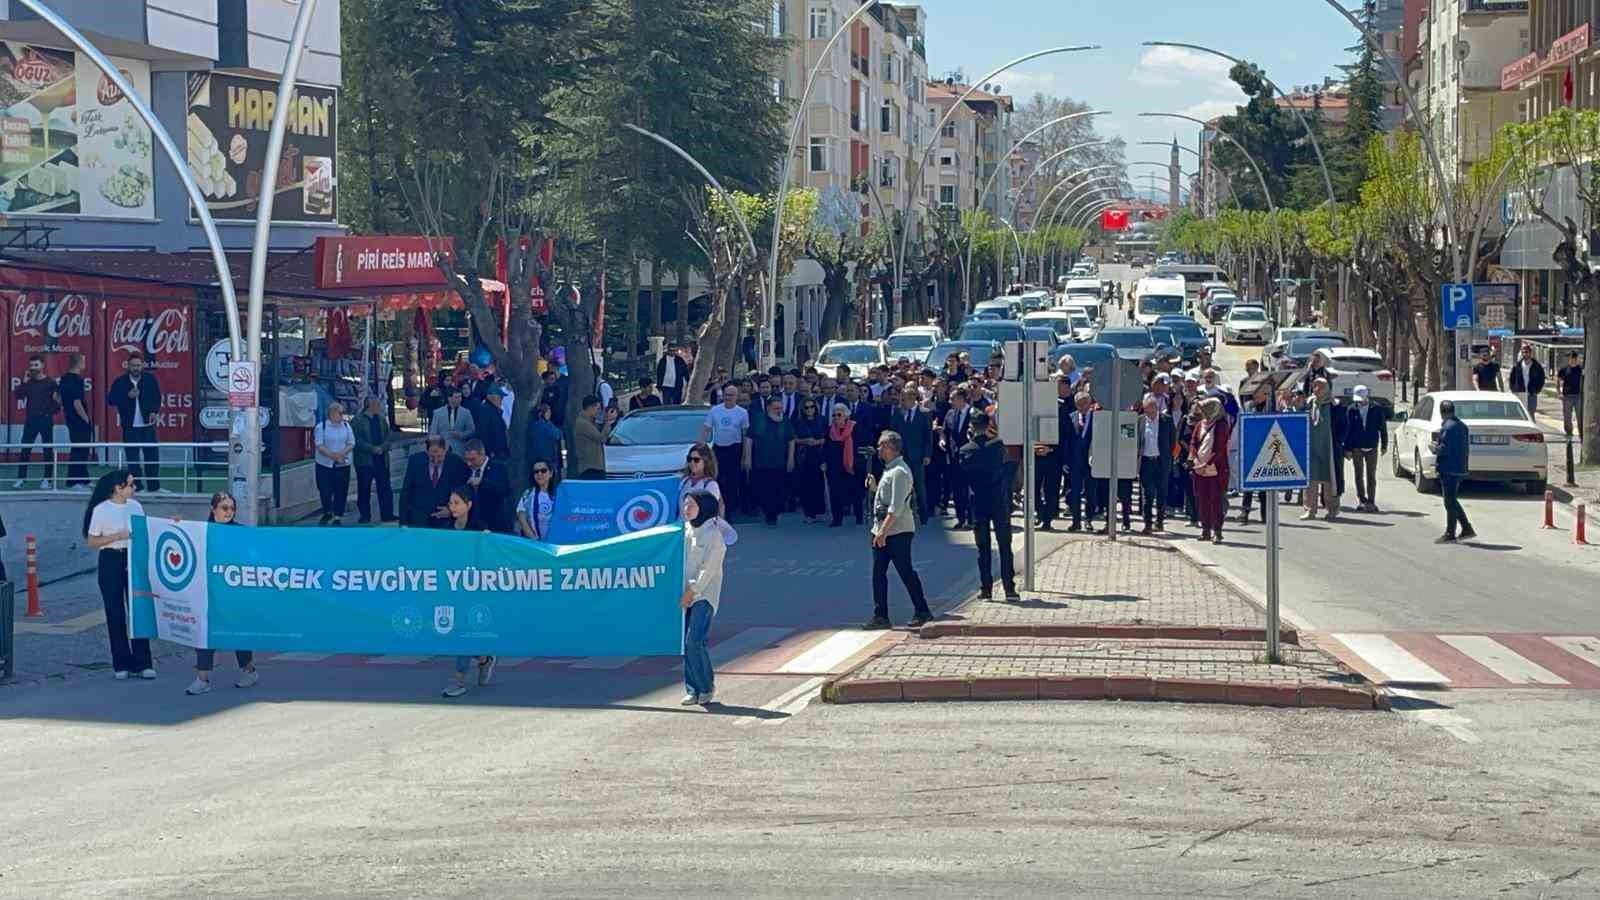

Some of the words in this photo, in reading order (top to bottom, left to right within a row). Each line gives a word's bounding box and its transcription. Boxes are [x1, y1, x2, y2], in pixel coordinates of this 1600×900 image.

[357, 248, 379, 270] PİRİ
[381, 248, 406, 269] REİS
[407, 251, 450, 268] MAR
[1450, 287, 1467, 312] P
[12, 293, 91, 338] Coca-Cola
[111, 308, 189, 354] Coca-Cola
[161, 393, 193, 408] EIS
[332, 566, 438, 592] SEVGİYE
[446, 566, 553, 592] YÜRÜME
